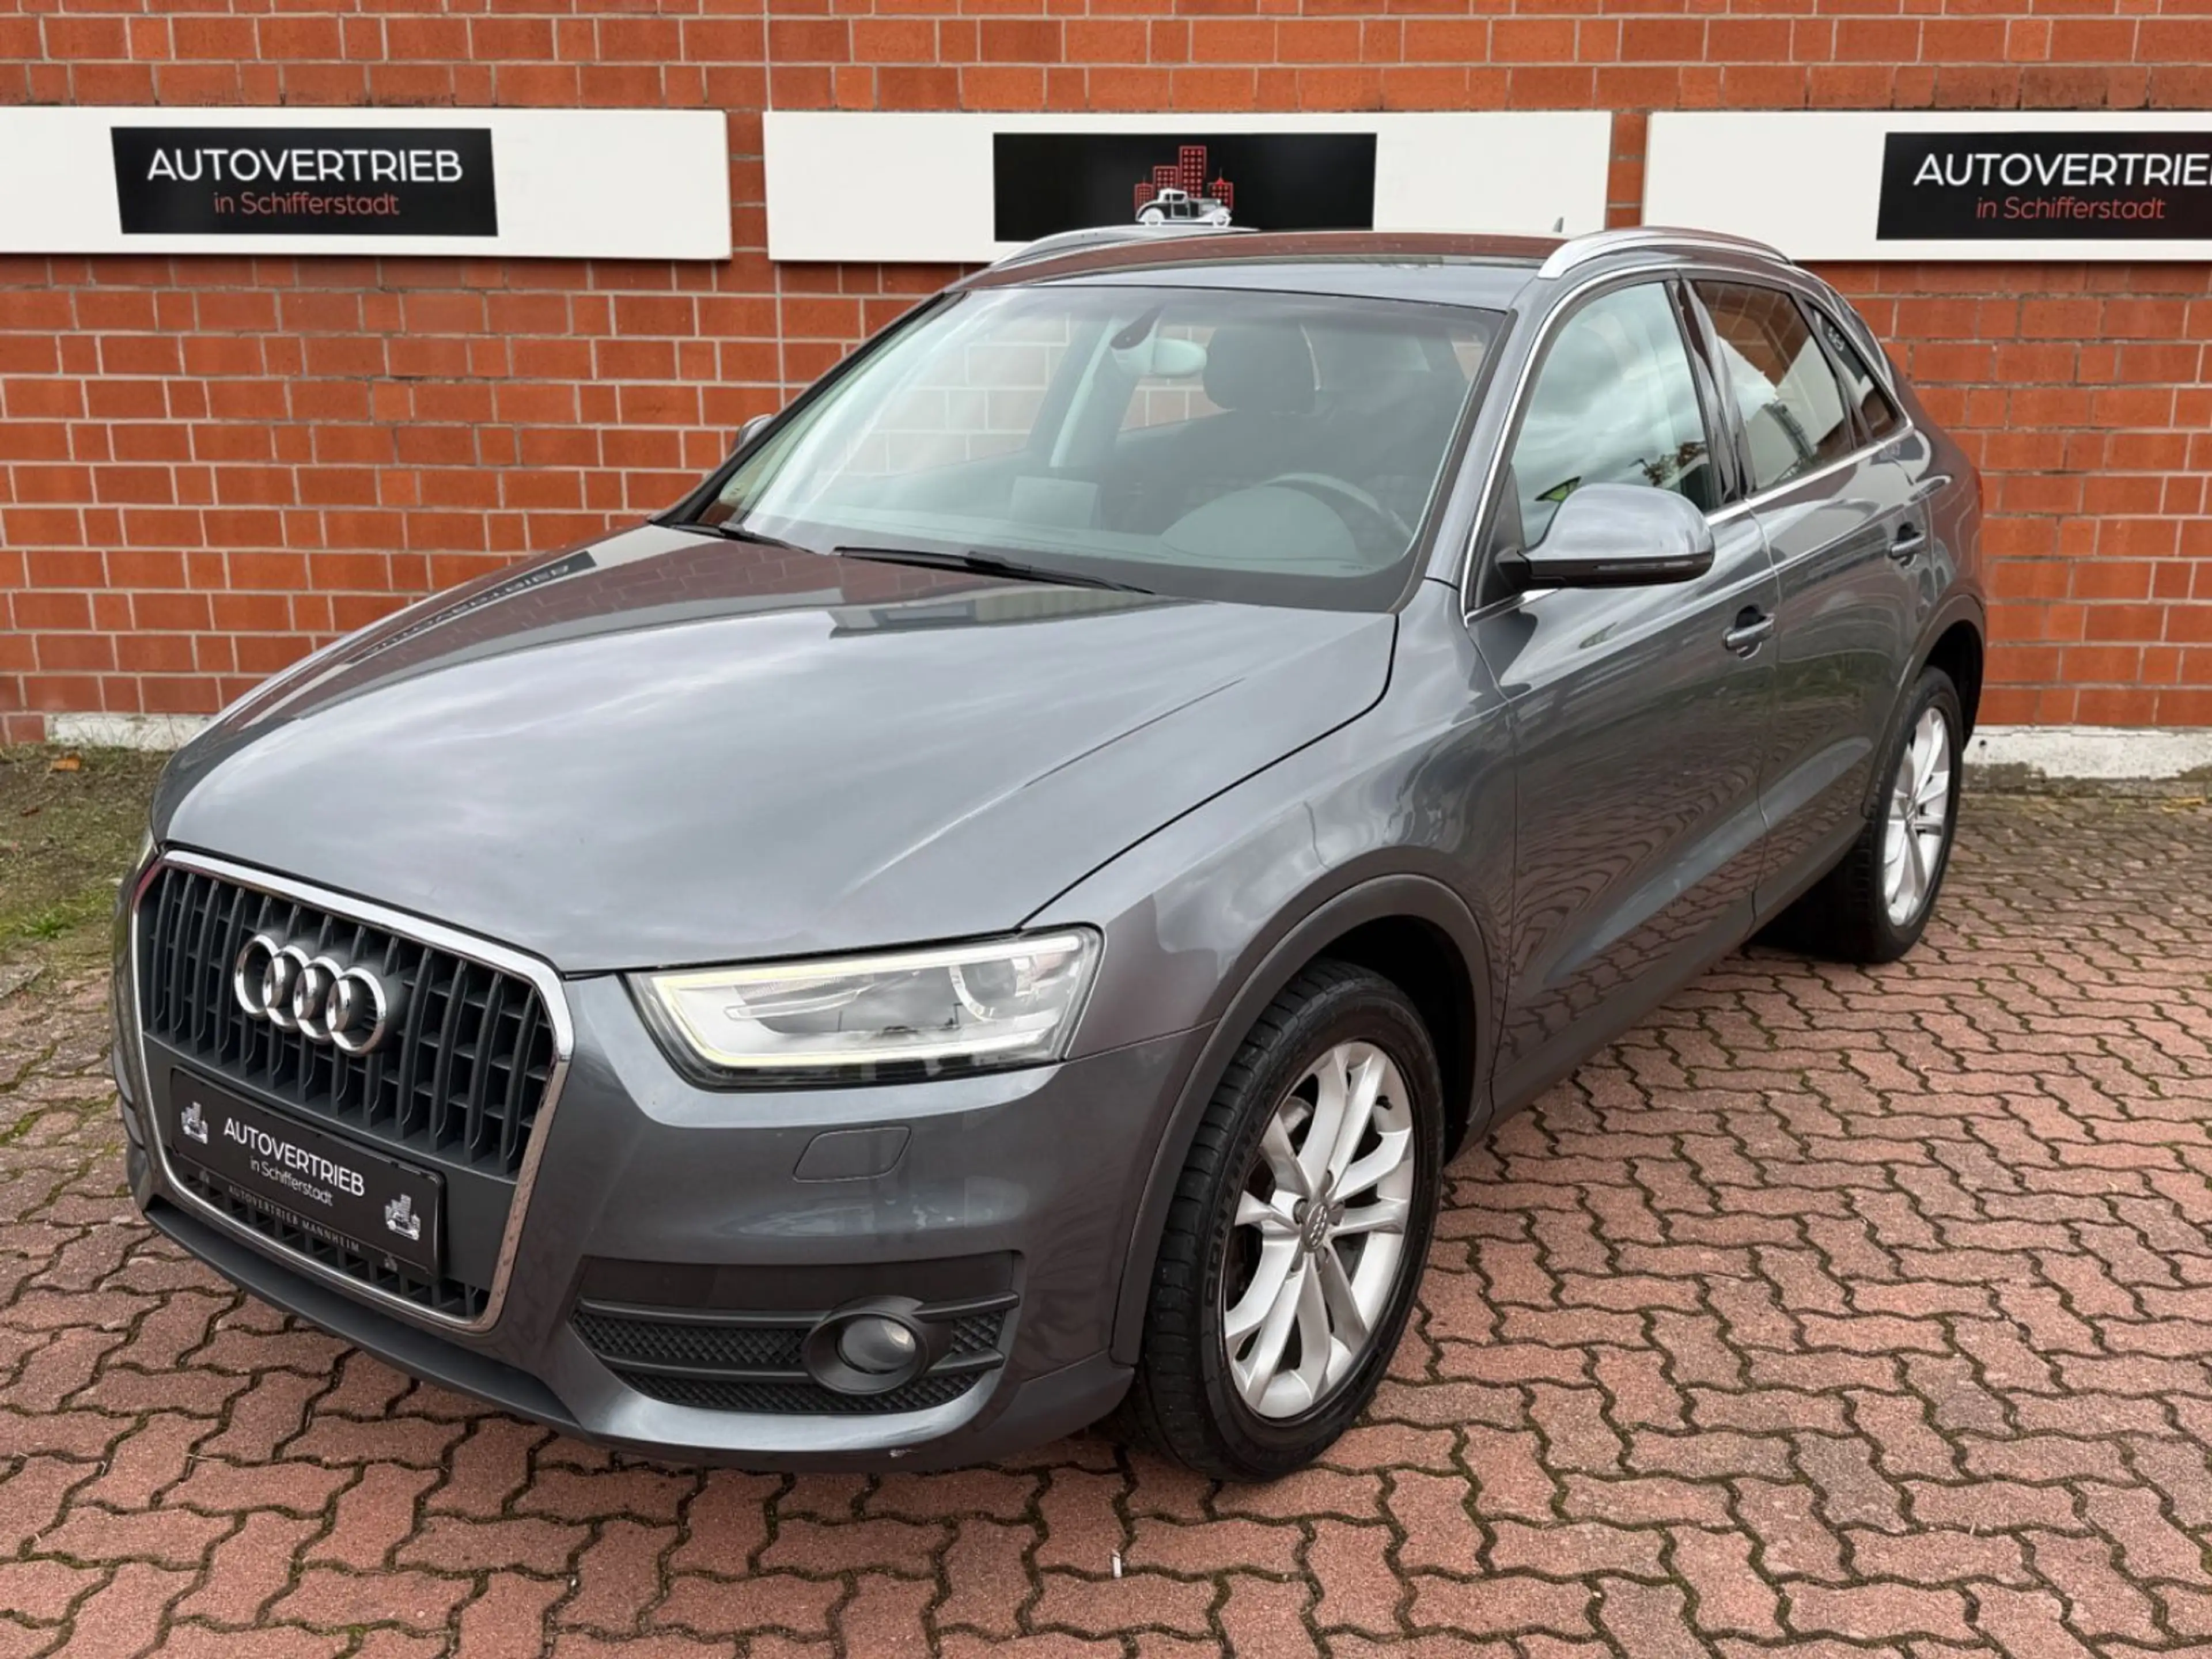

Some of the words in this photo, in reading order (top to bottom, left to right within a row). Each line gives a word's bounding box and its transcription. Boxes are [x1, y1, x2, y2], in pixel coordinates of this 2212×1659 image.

[147, 148, 463, 183] AUTOVERTRIEB
[1912, 153, 2212, 186] AUTOVERTRIE
[214, 192, 234, 214] in
[241, 191, 400, 215] Schifferstadt
[1976, 198, 1997, 219] in
[2003, 197, 2166, 219] Schifferstadt
[224, 1117, 365, 1197] AUTOVERTRIEB
[250, 1156, 259, 1172] in
[262, 1161, 333, 1207] Schifferstadt
